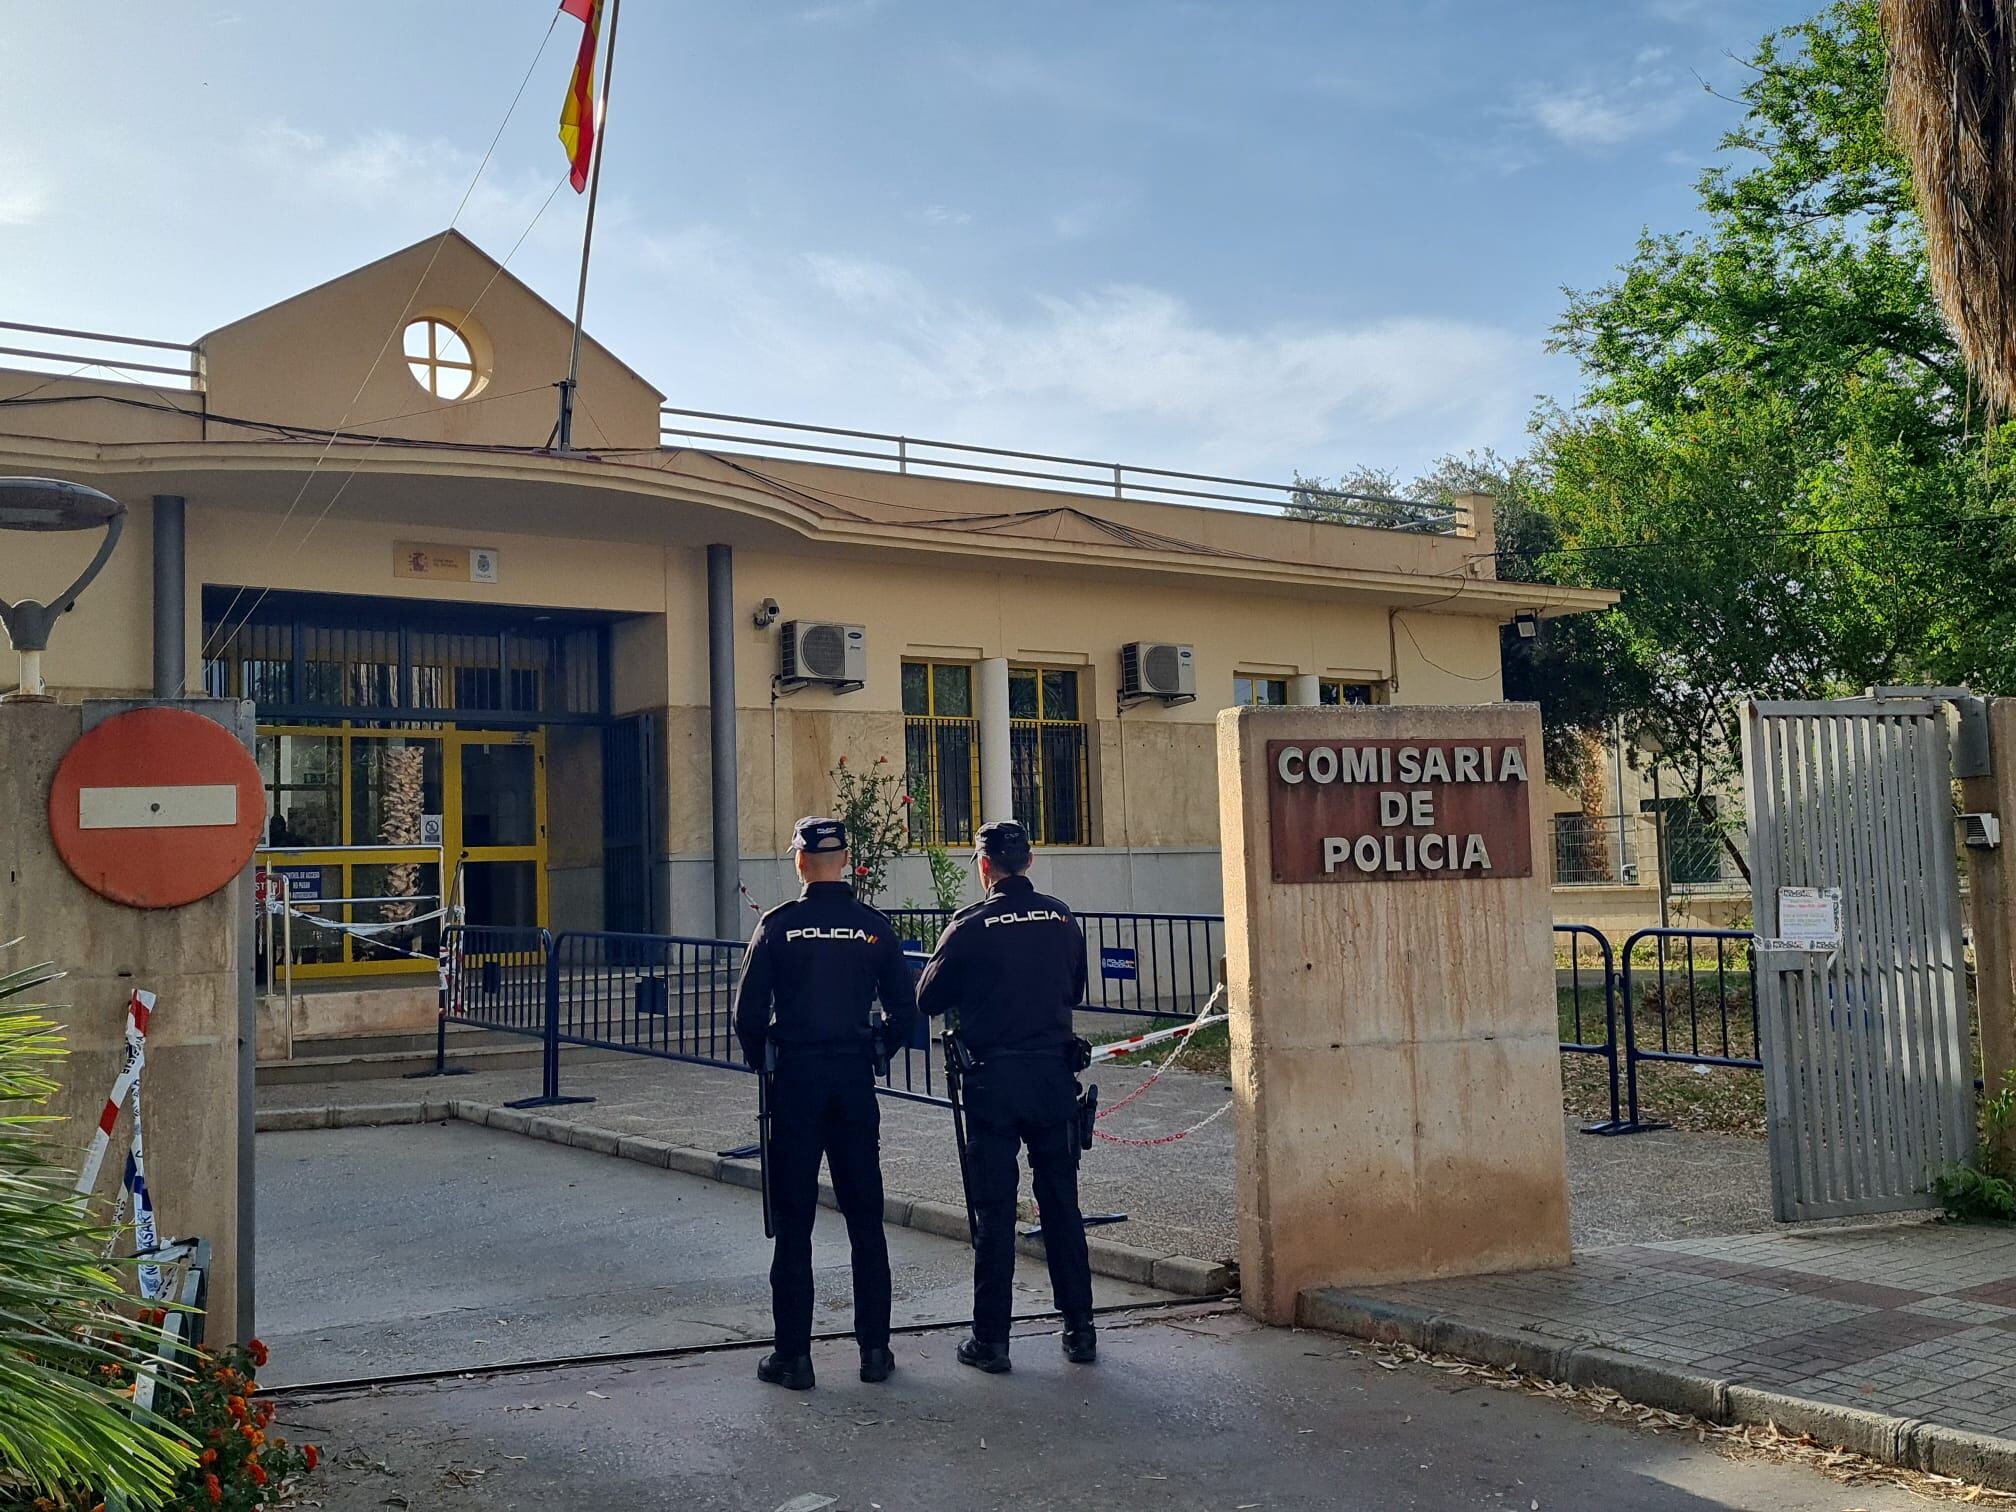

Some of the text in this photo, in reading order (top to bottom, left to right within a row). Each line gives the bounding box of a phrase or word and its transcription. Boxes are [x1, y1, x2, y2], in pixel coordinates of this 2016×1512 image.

[1278, 746, 1528, 784] COMISARIA
[1380, 790, 1435, 827] DE
[1323, 833, 1492, 873] POLICIA
[255, 881, 277, 898] STP
[786, 927, 867, 942] POLICIA
[984, 910, 1061, 927] POLICIA
[141, 1215, 155, 1249] ASAR
